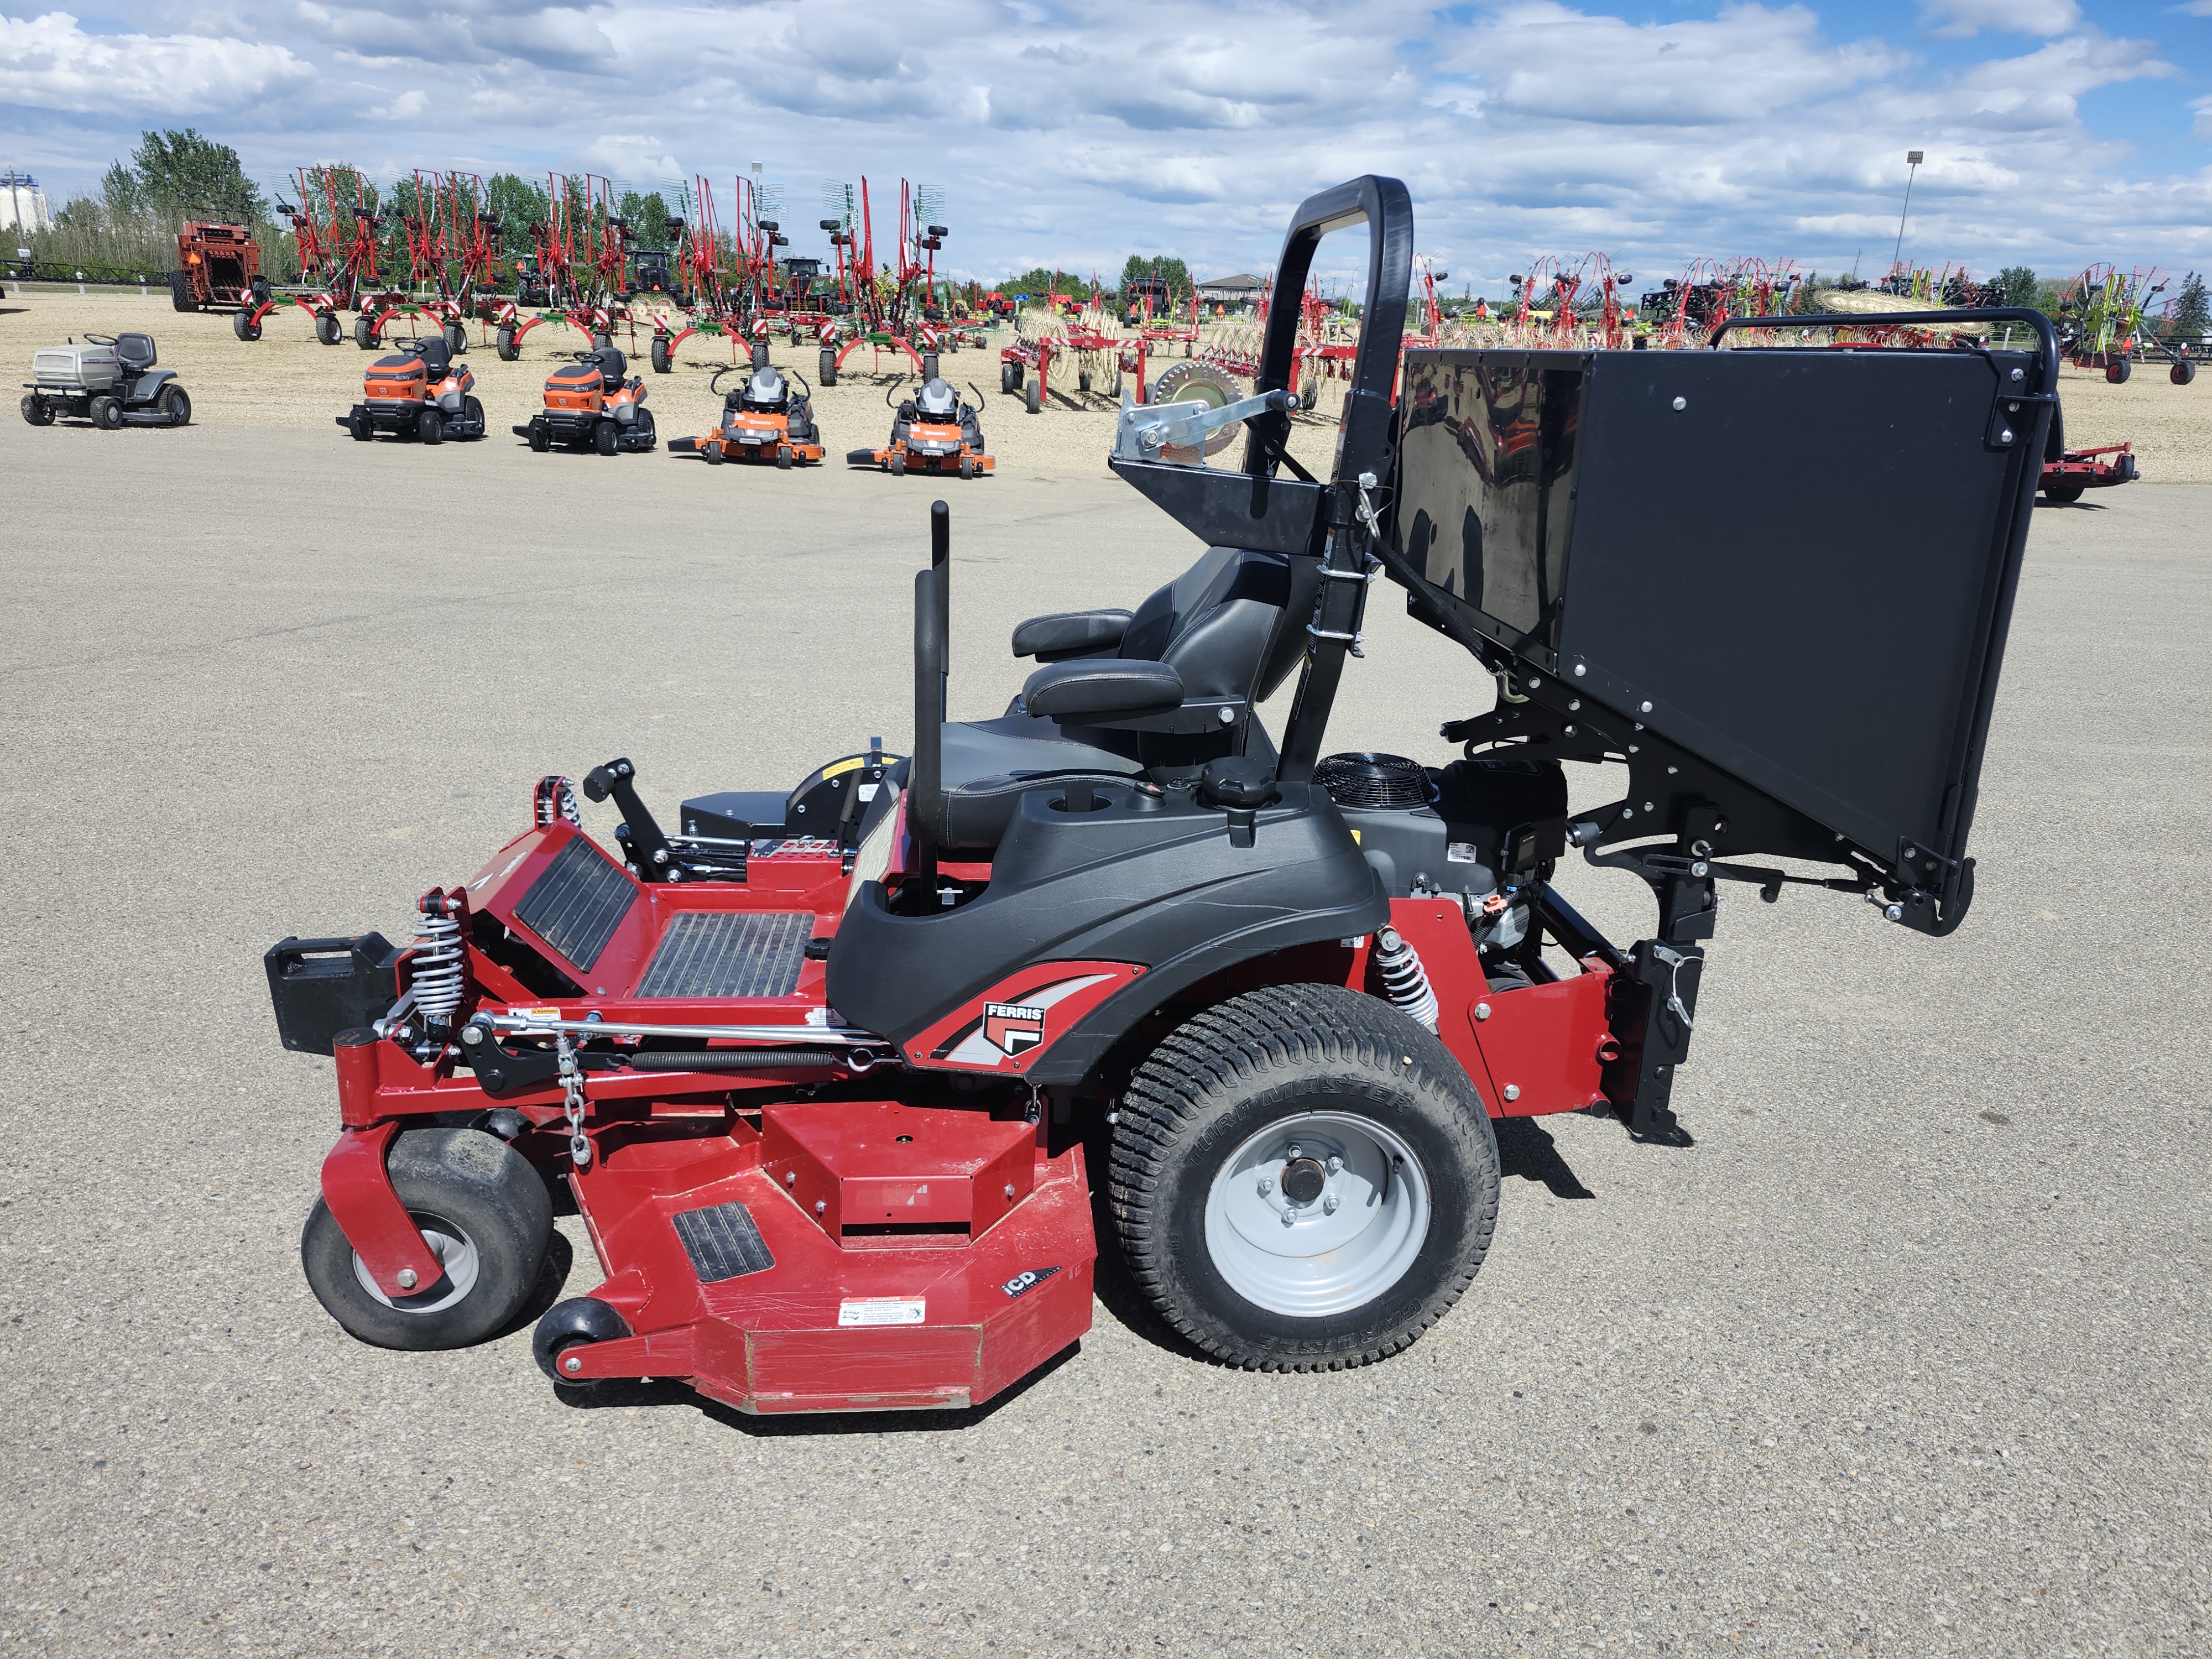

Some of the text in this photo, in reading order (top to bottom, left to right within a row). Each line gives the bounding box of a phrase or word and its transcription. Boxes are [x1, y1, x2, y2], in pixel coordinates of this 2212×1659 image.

[988, 1005, 1042, 1020] FERRIS
[1184, 1076, 1413, 1166] TURF MASTER
[1001, 1271, 1036, 1295] iCD
[1252, 1298, 1423, 1355] CARLISLE
